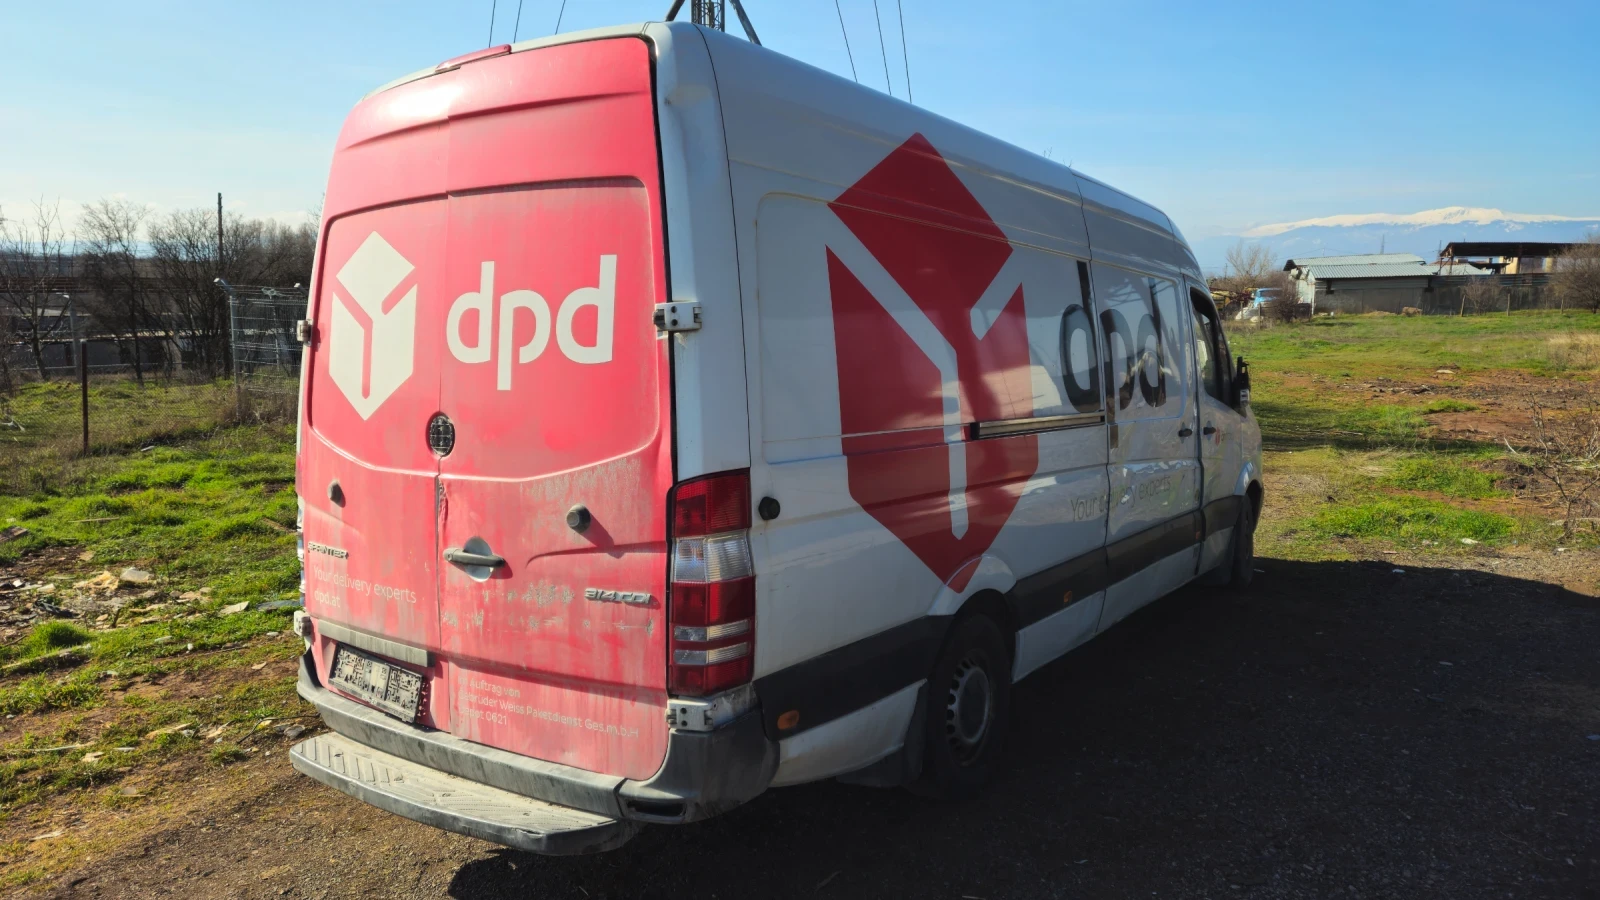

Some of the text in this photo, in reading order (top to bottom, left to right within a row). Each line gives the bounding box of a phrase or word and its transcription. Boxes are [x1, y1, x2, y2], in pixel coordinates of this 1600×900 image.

[446, 254, 617, 391] dpd
[1070, 496, 1097, 522] Your
[314, 564, 417, 604] Your delivery experts
[584, 587, 652, 604] 314 CDI
[314, 588, 341, 608] dpd.at
[469, 677, 502, 697] Auftrag
[503, 687, 521, 699] von
[485, 710, 507, 726] 0621
[498, 699, 525, 715] Weiss
[526, 705, 584, 728] Paketdienst
